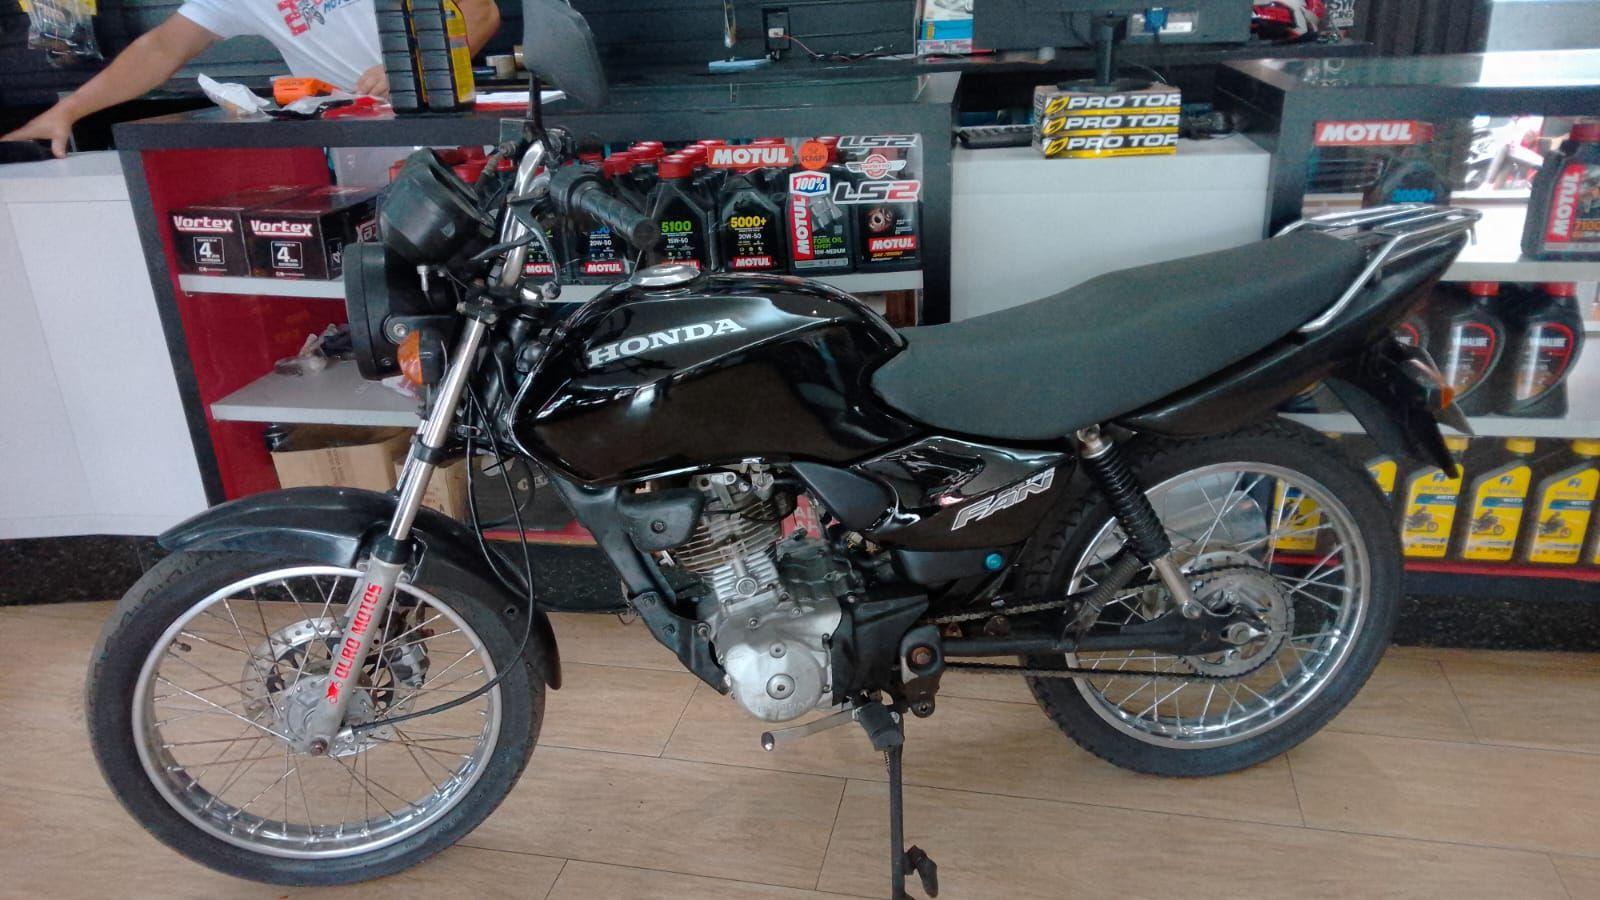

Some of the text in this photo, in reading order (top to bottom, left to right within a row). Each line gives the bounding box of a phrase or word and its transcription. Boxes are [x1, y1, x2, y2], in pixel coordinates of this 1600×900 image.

[1067, 95, 1126, 110] PRO
[1064, 115, 1122, 130] PRO
[1319, 123, 1412, 141] MOTUL
[837, 135, 918, 149] LS2
[1066, 136, 1122, 150] PRO
[712, 147, 790, 165] MOTUL
[795, 177, 825, 190] 100%
[833, 181, 920, 204] LS2
[1553, 174, 1580, 237] MOTUL
[173, 216, 234, 232] Vortex
[251, 220, 313, 237] Vortex
[662, 221, 692, 232] 5100
[731, 216, 766, 228] 5000+
[794, 198, 811, 255] MOTUL
[199, 242, 212, 258] 4
[871, 238, 914, 250] MOTUL
[277, 246, 290, 262] 4
[735, 257, 771, 267] MOTUL
[526, 264, 554, 273] MOTU
[587, 263, 621, 273] MOTUL
[588, 318, 748, 369] HONDA
[951, 467, 1056, 531] FAN
[351, 582, 383, 636] MOTOS
